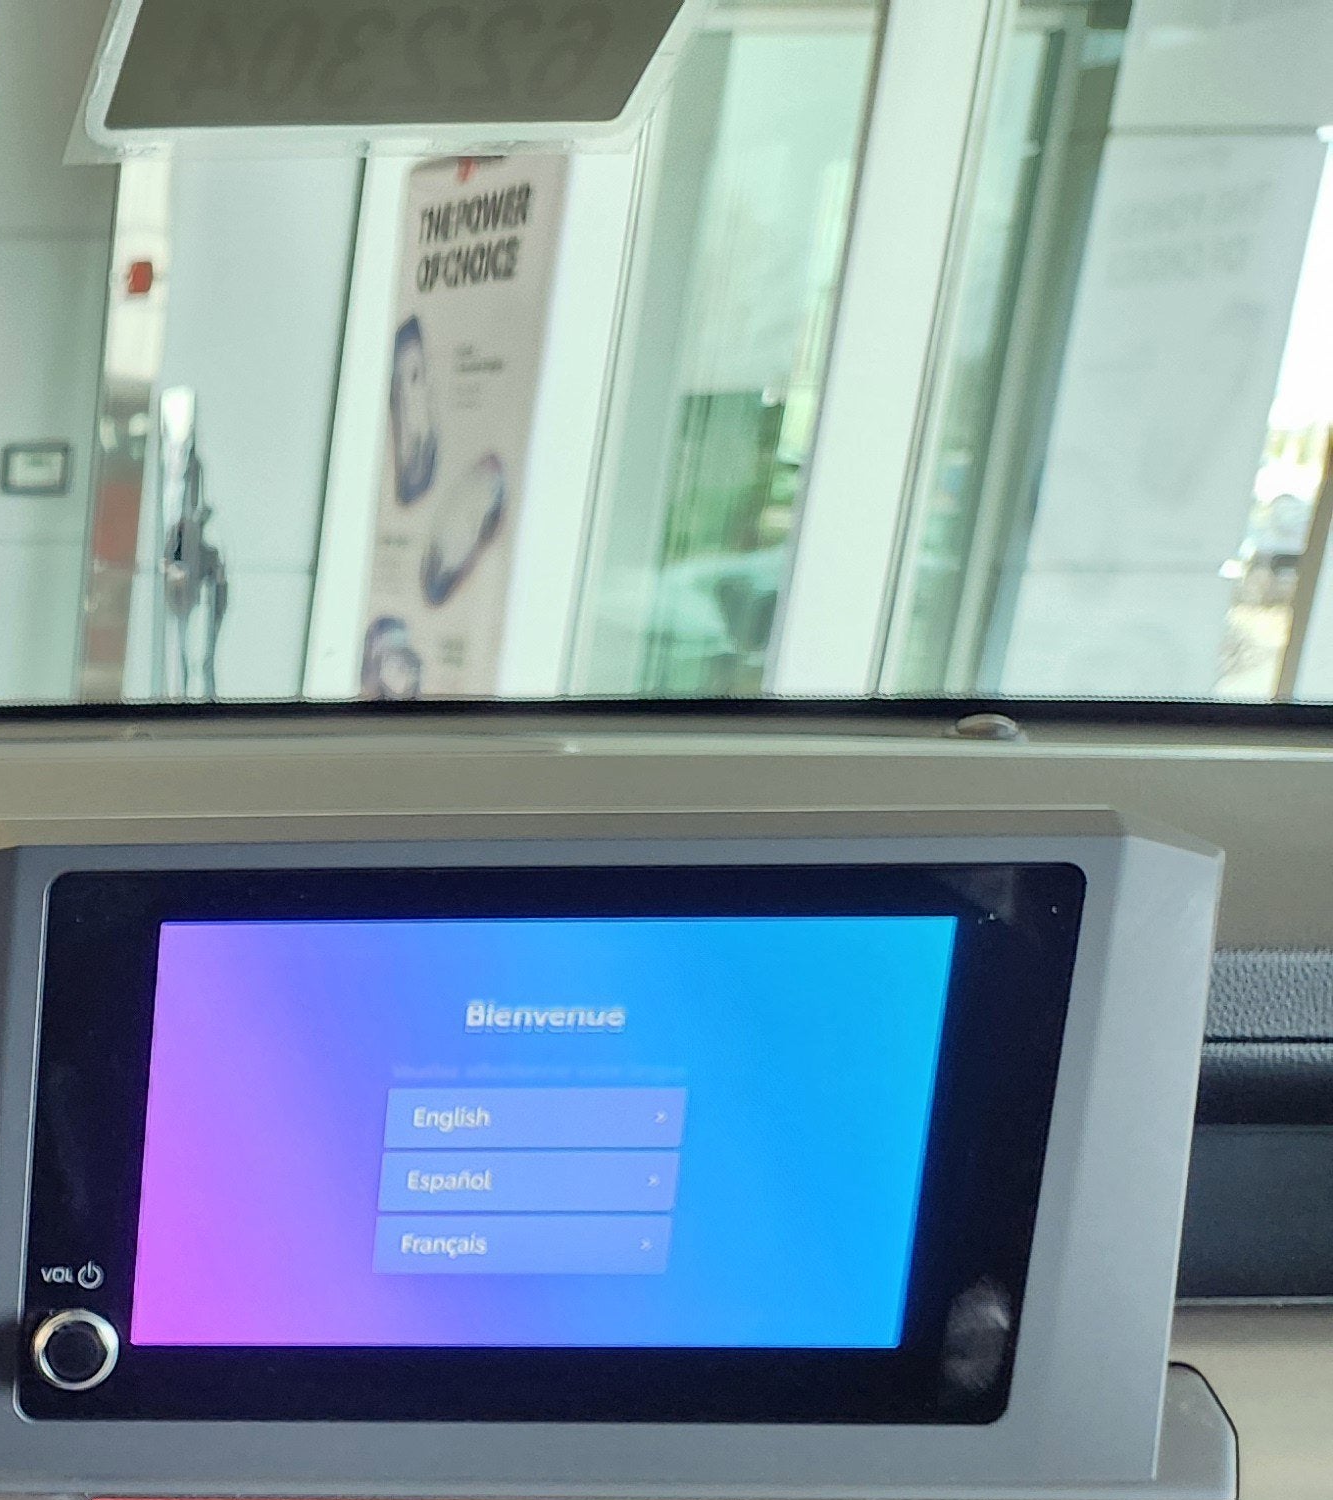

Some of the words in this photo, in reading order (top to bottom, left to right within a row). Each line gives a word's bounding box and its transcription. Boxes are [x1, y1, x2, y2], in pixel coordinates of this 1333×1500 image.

[418, 201, 452, 244] THE
[454, 182, 531, 238] POWER
[416, 252, 441, 293] OF
[443, 235, 521, 289] CHOICE
[465, 1001, 627, 1030] Bienvenue
[412, 1106, 490, 1133] English
[406, 1169, 492, 1194] Español
[400, 1232, 488, 1259] Français
[40, 1266, 74, 1283] VOL
